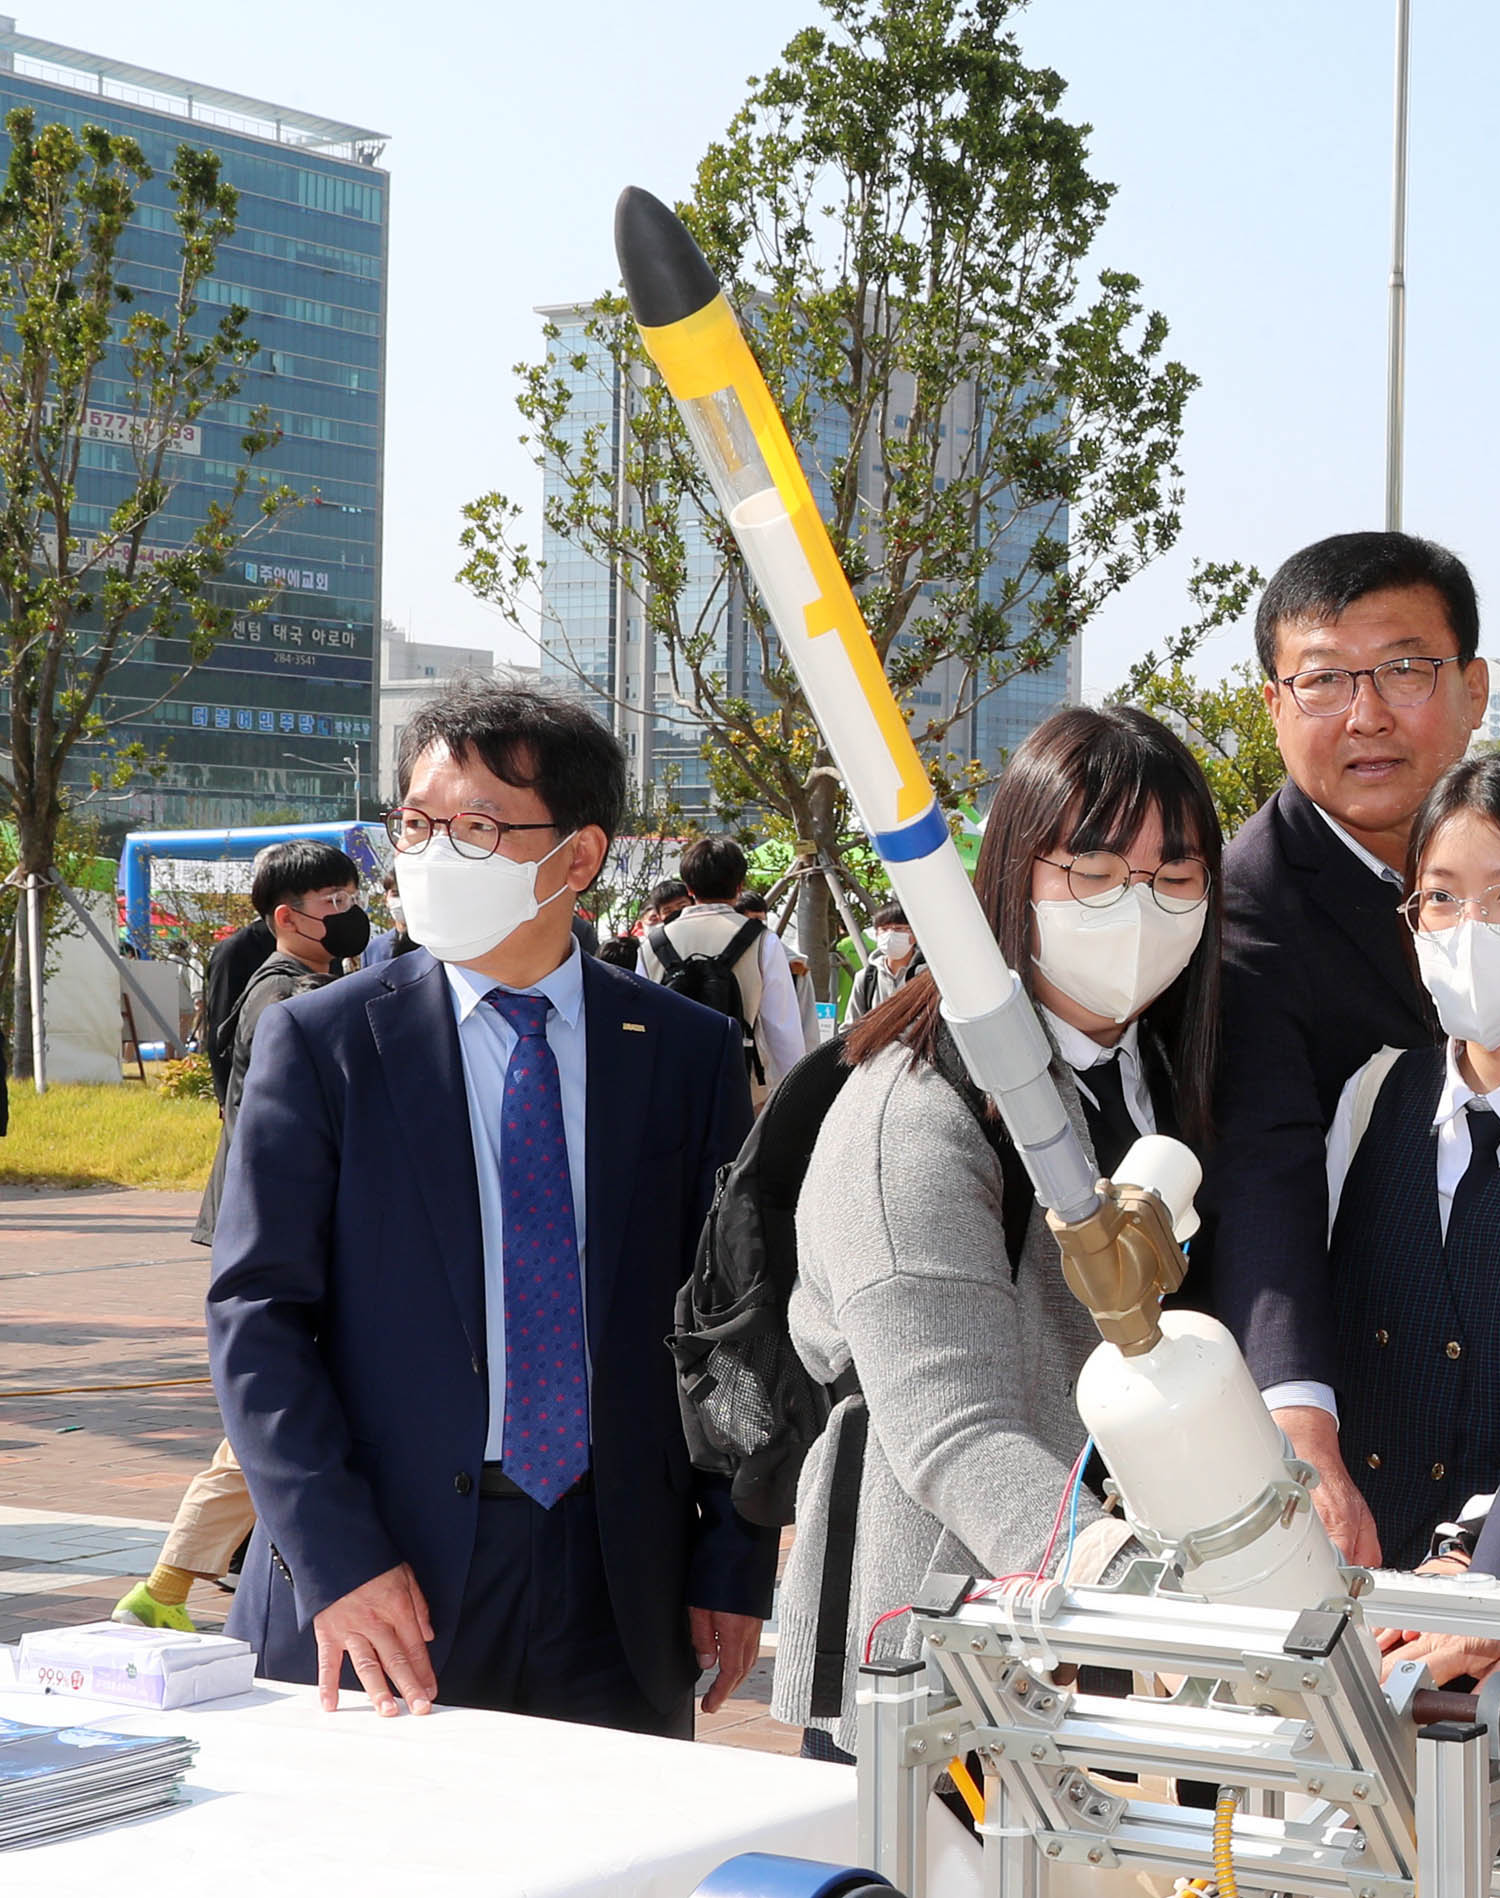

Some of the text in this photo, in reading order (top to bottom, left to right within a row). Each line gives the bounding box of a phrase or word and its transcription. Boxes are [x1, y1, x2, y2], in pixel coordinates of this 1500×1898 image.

[231, 619, 356, 649] 센텀 태국 아로마
[191, 705, 316, 735] 더불어민주당
